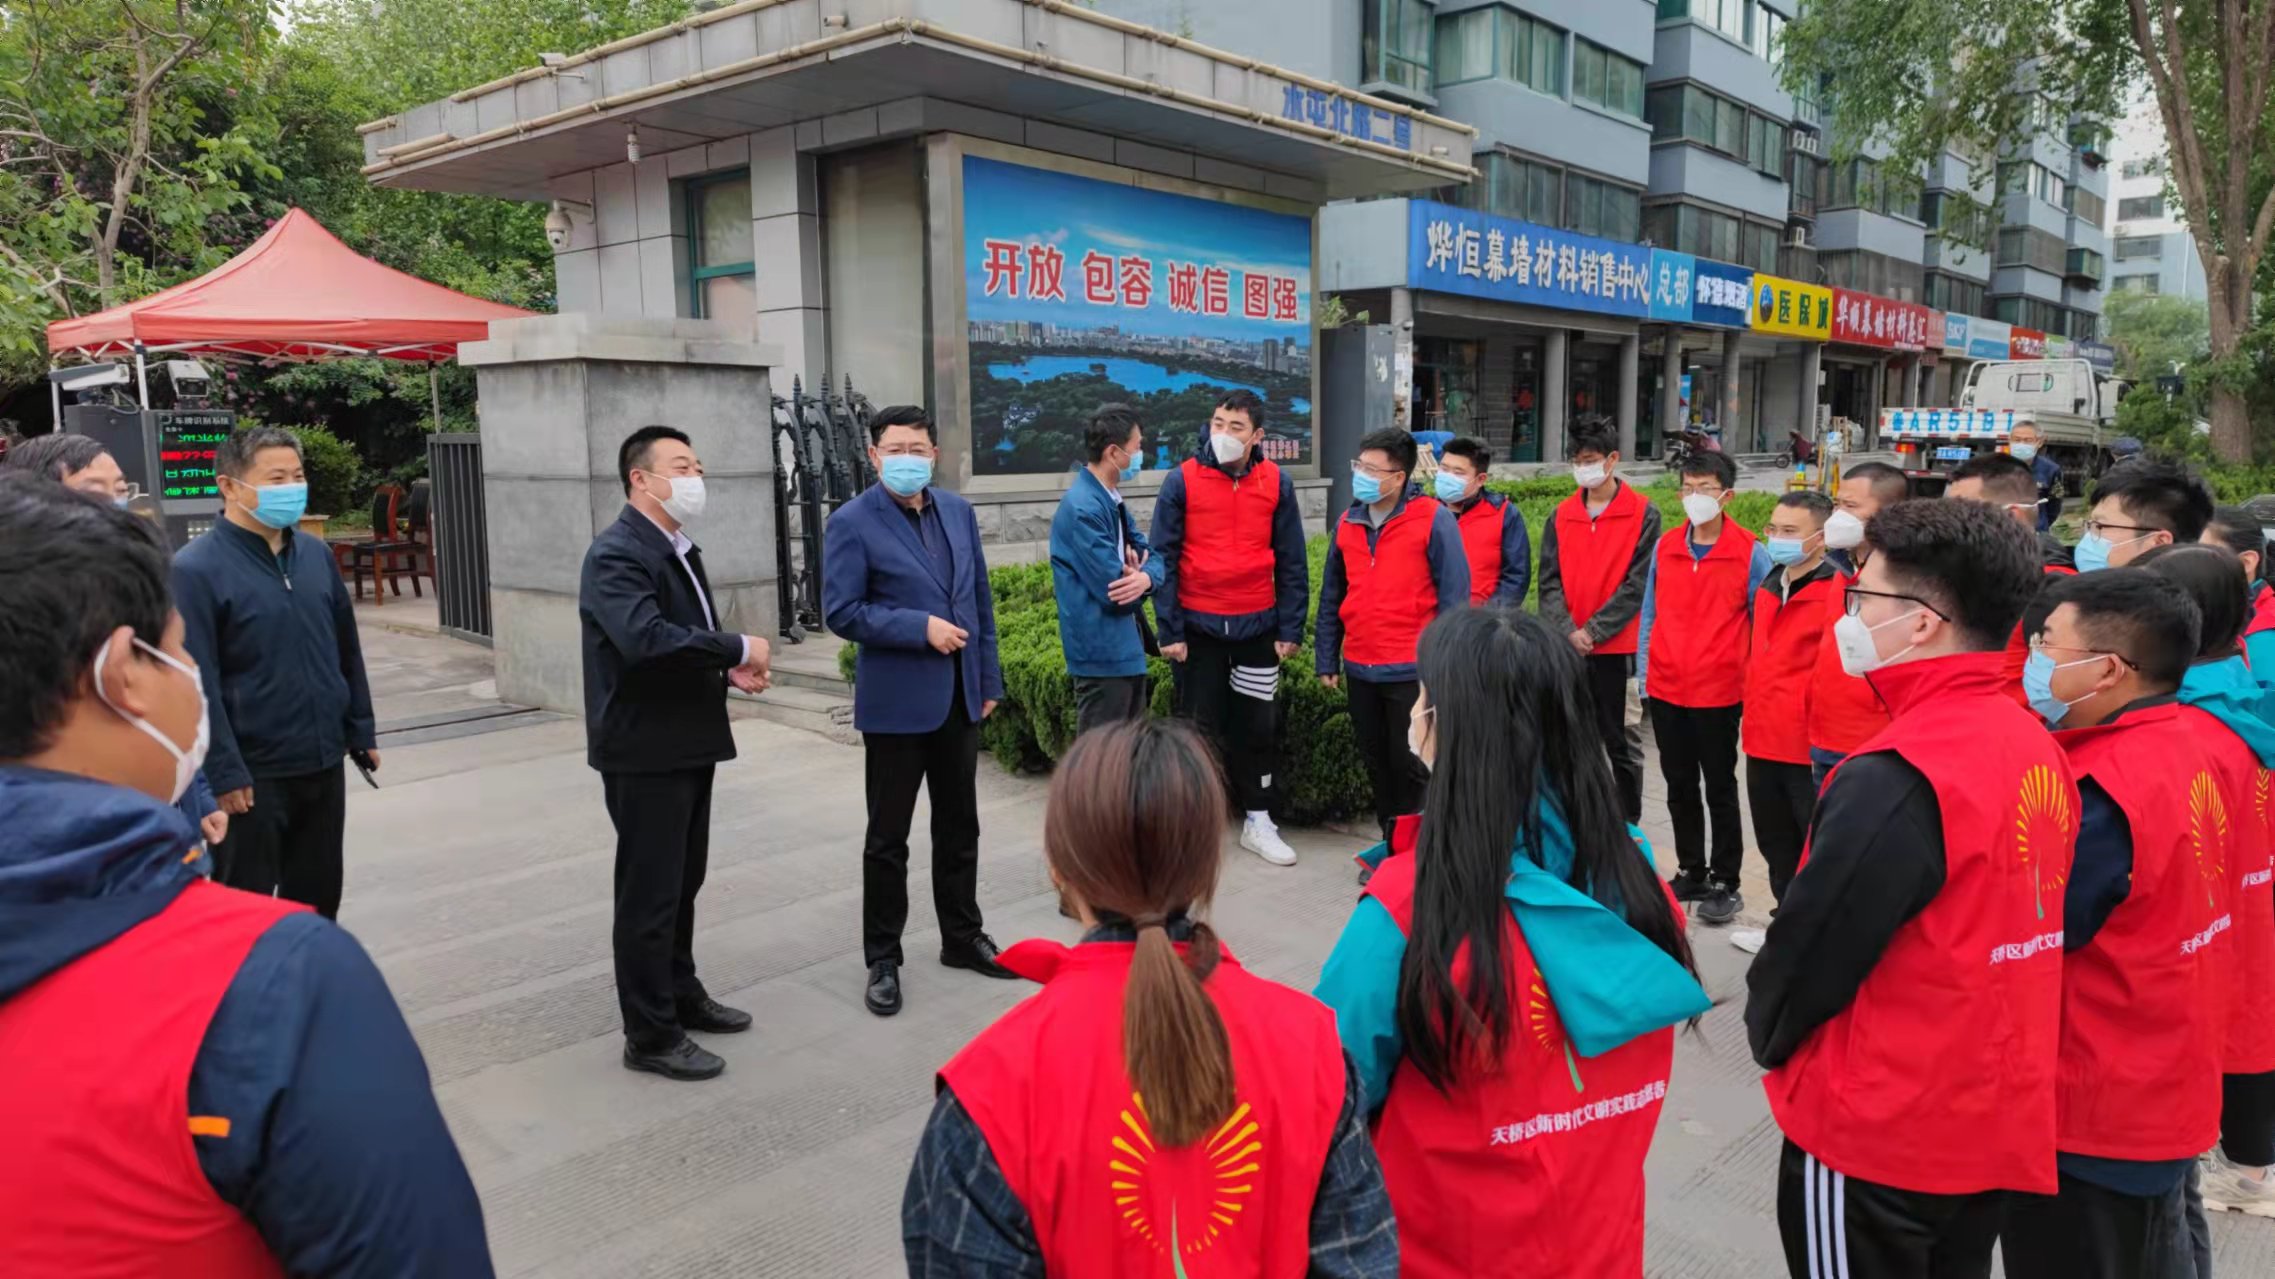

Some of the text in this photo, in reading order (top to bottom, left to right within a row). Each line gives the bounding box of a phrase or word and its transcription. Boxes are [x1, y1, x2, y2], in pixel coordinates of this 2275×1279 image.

[983, 239, 1298, 321] 开放 包容 诚信 图强
[1426, 219, 1650, 305] 烨恒幕墙材料销售中心
[1656, 261, 1690, 308] 总部
